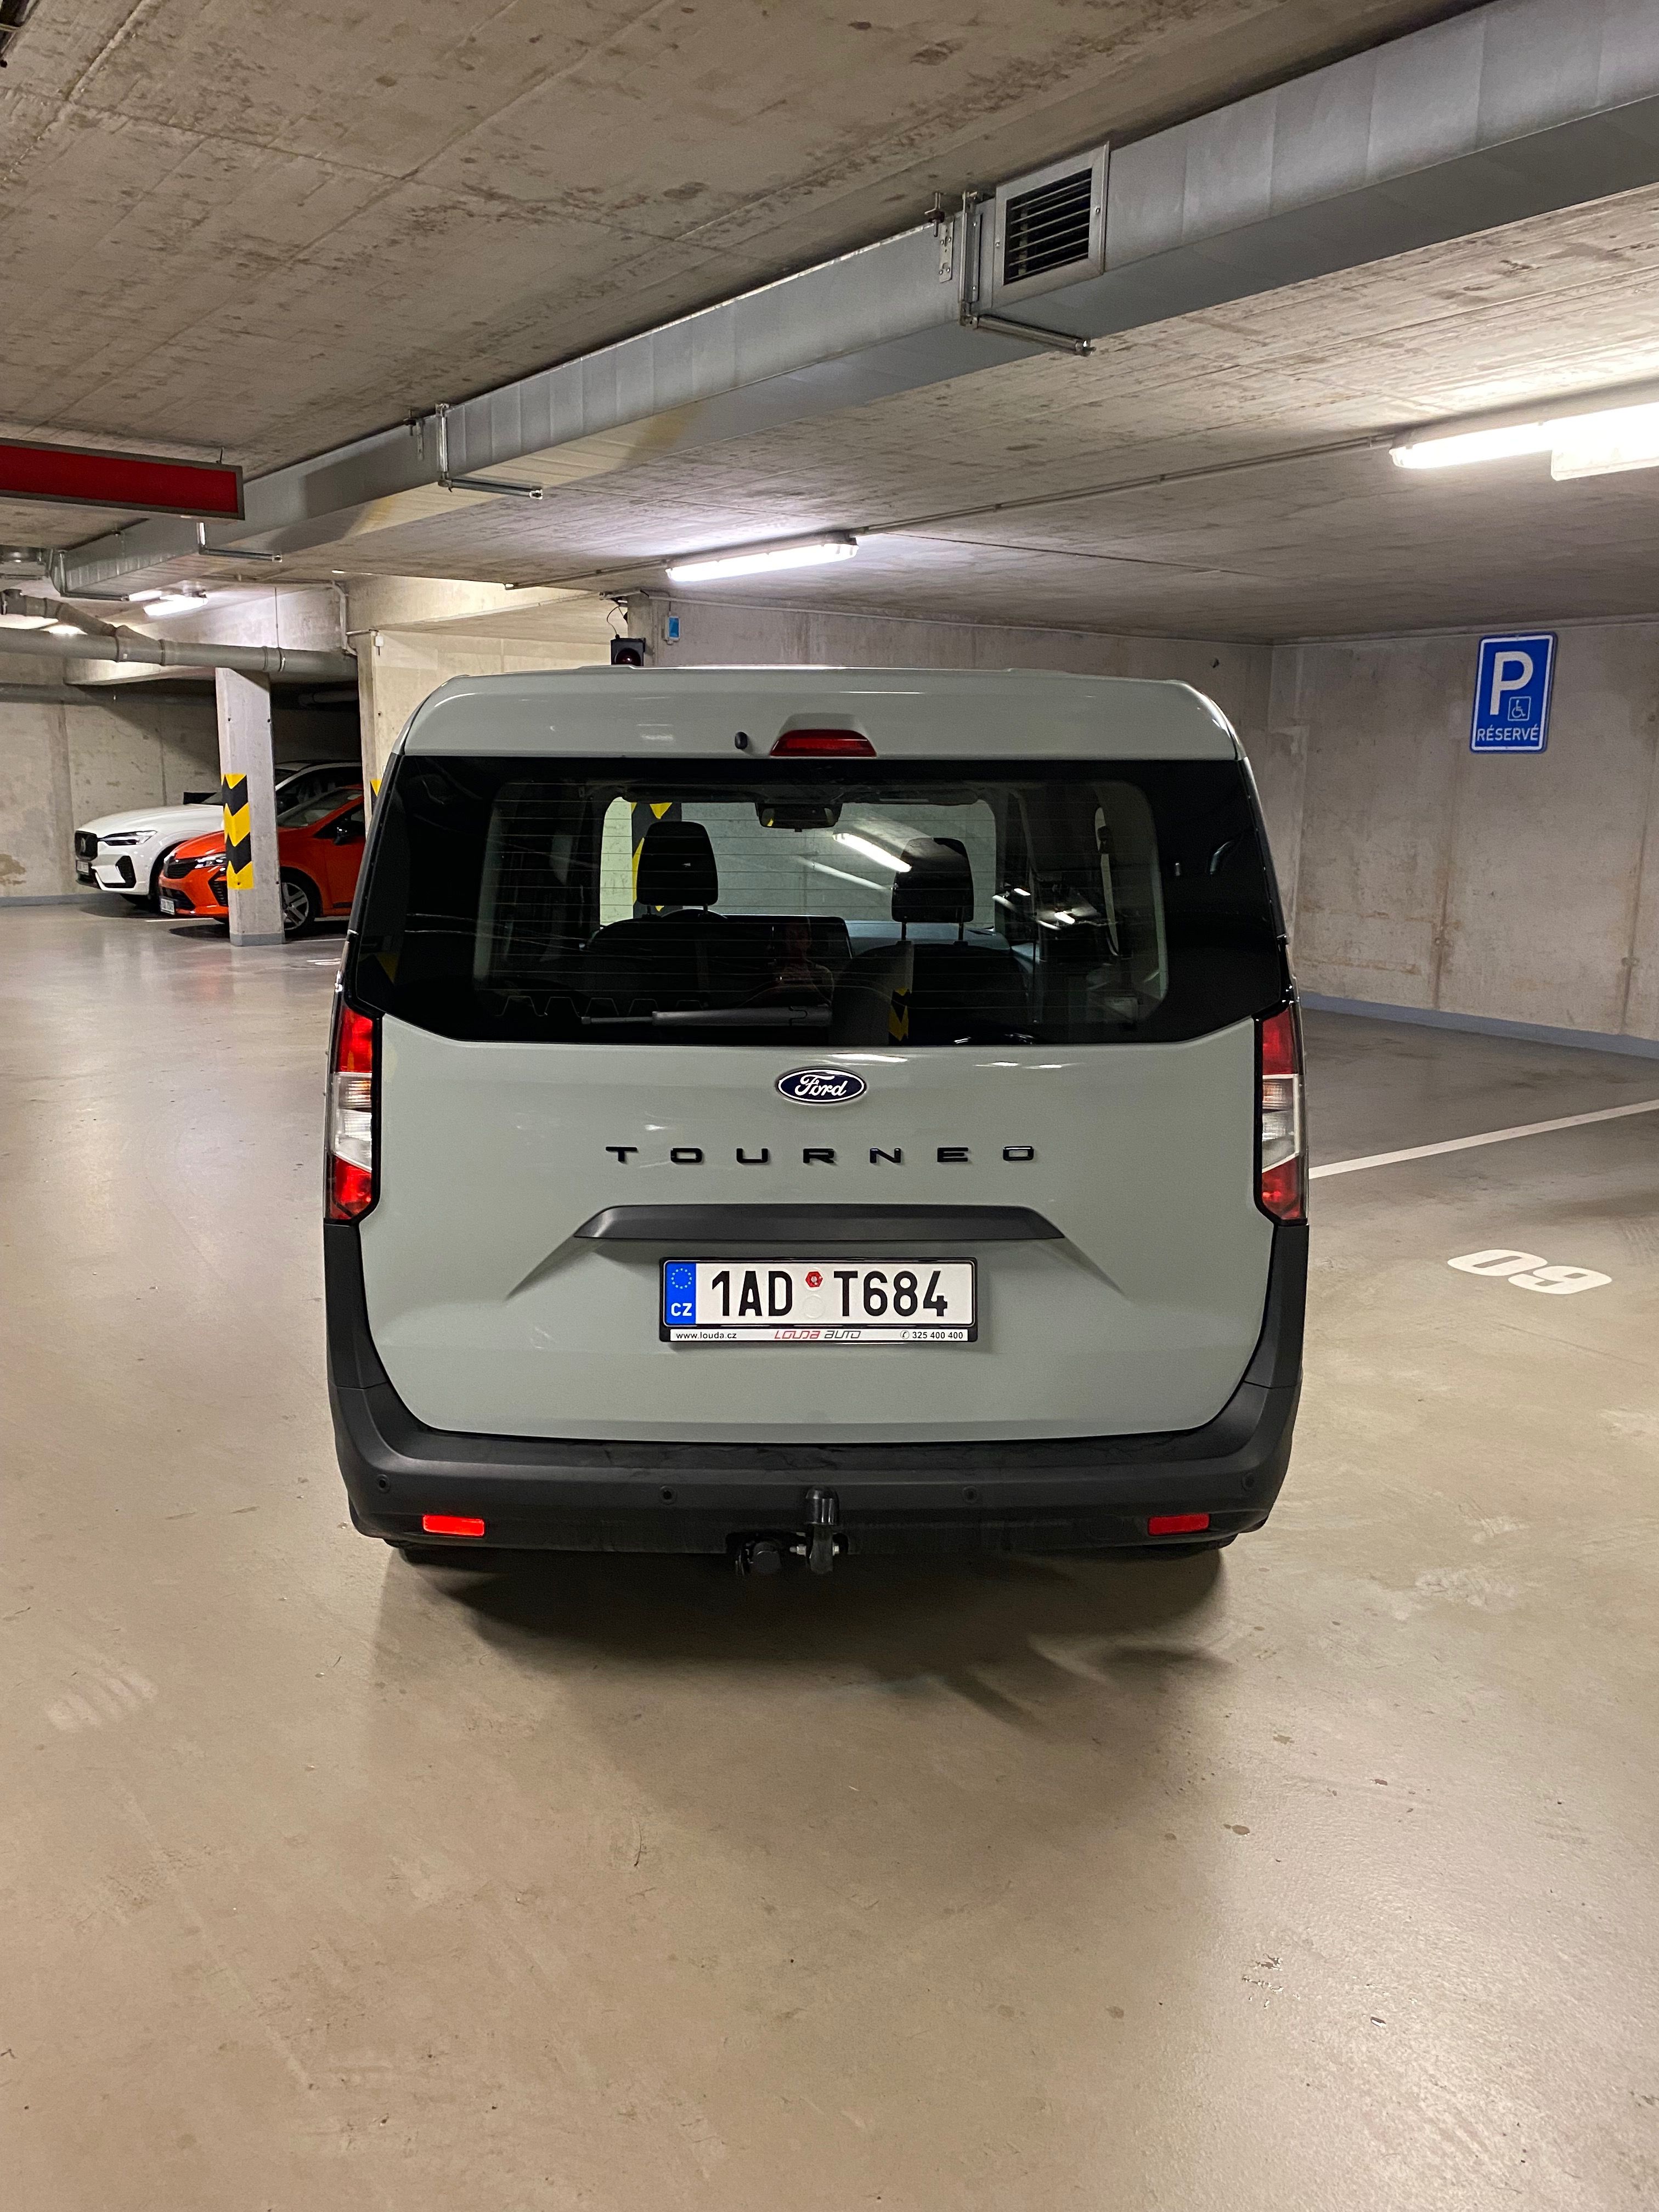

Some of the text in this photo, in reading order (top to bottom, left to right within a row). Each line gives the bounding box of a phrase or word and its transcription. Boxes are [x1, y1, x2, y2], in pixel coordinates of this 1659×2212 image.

[1490, 651, 1533, 715] P
[1477, 723, 1539, 741] RÉSERVÉ
[794, 1074, 847, 1096] Ford
[606, 1146, 1035, 1165] TOURNEO
[712, 1271, 947, 1317] 1AD T684
[671, 1304, 692, 1316] CZ
